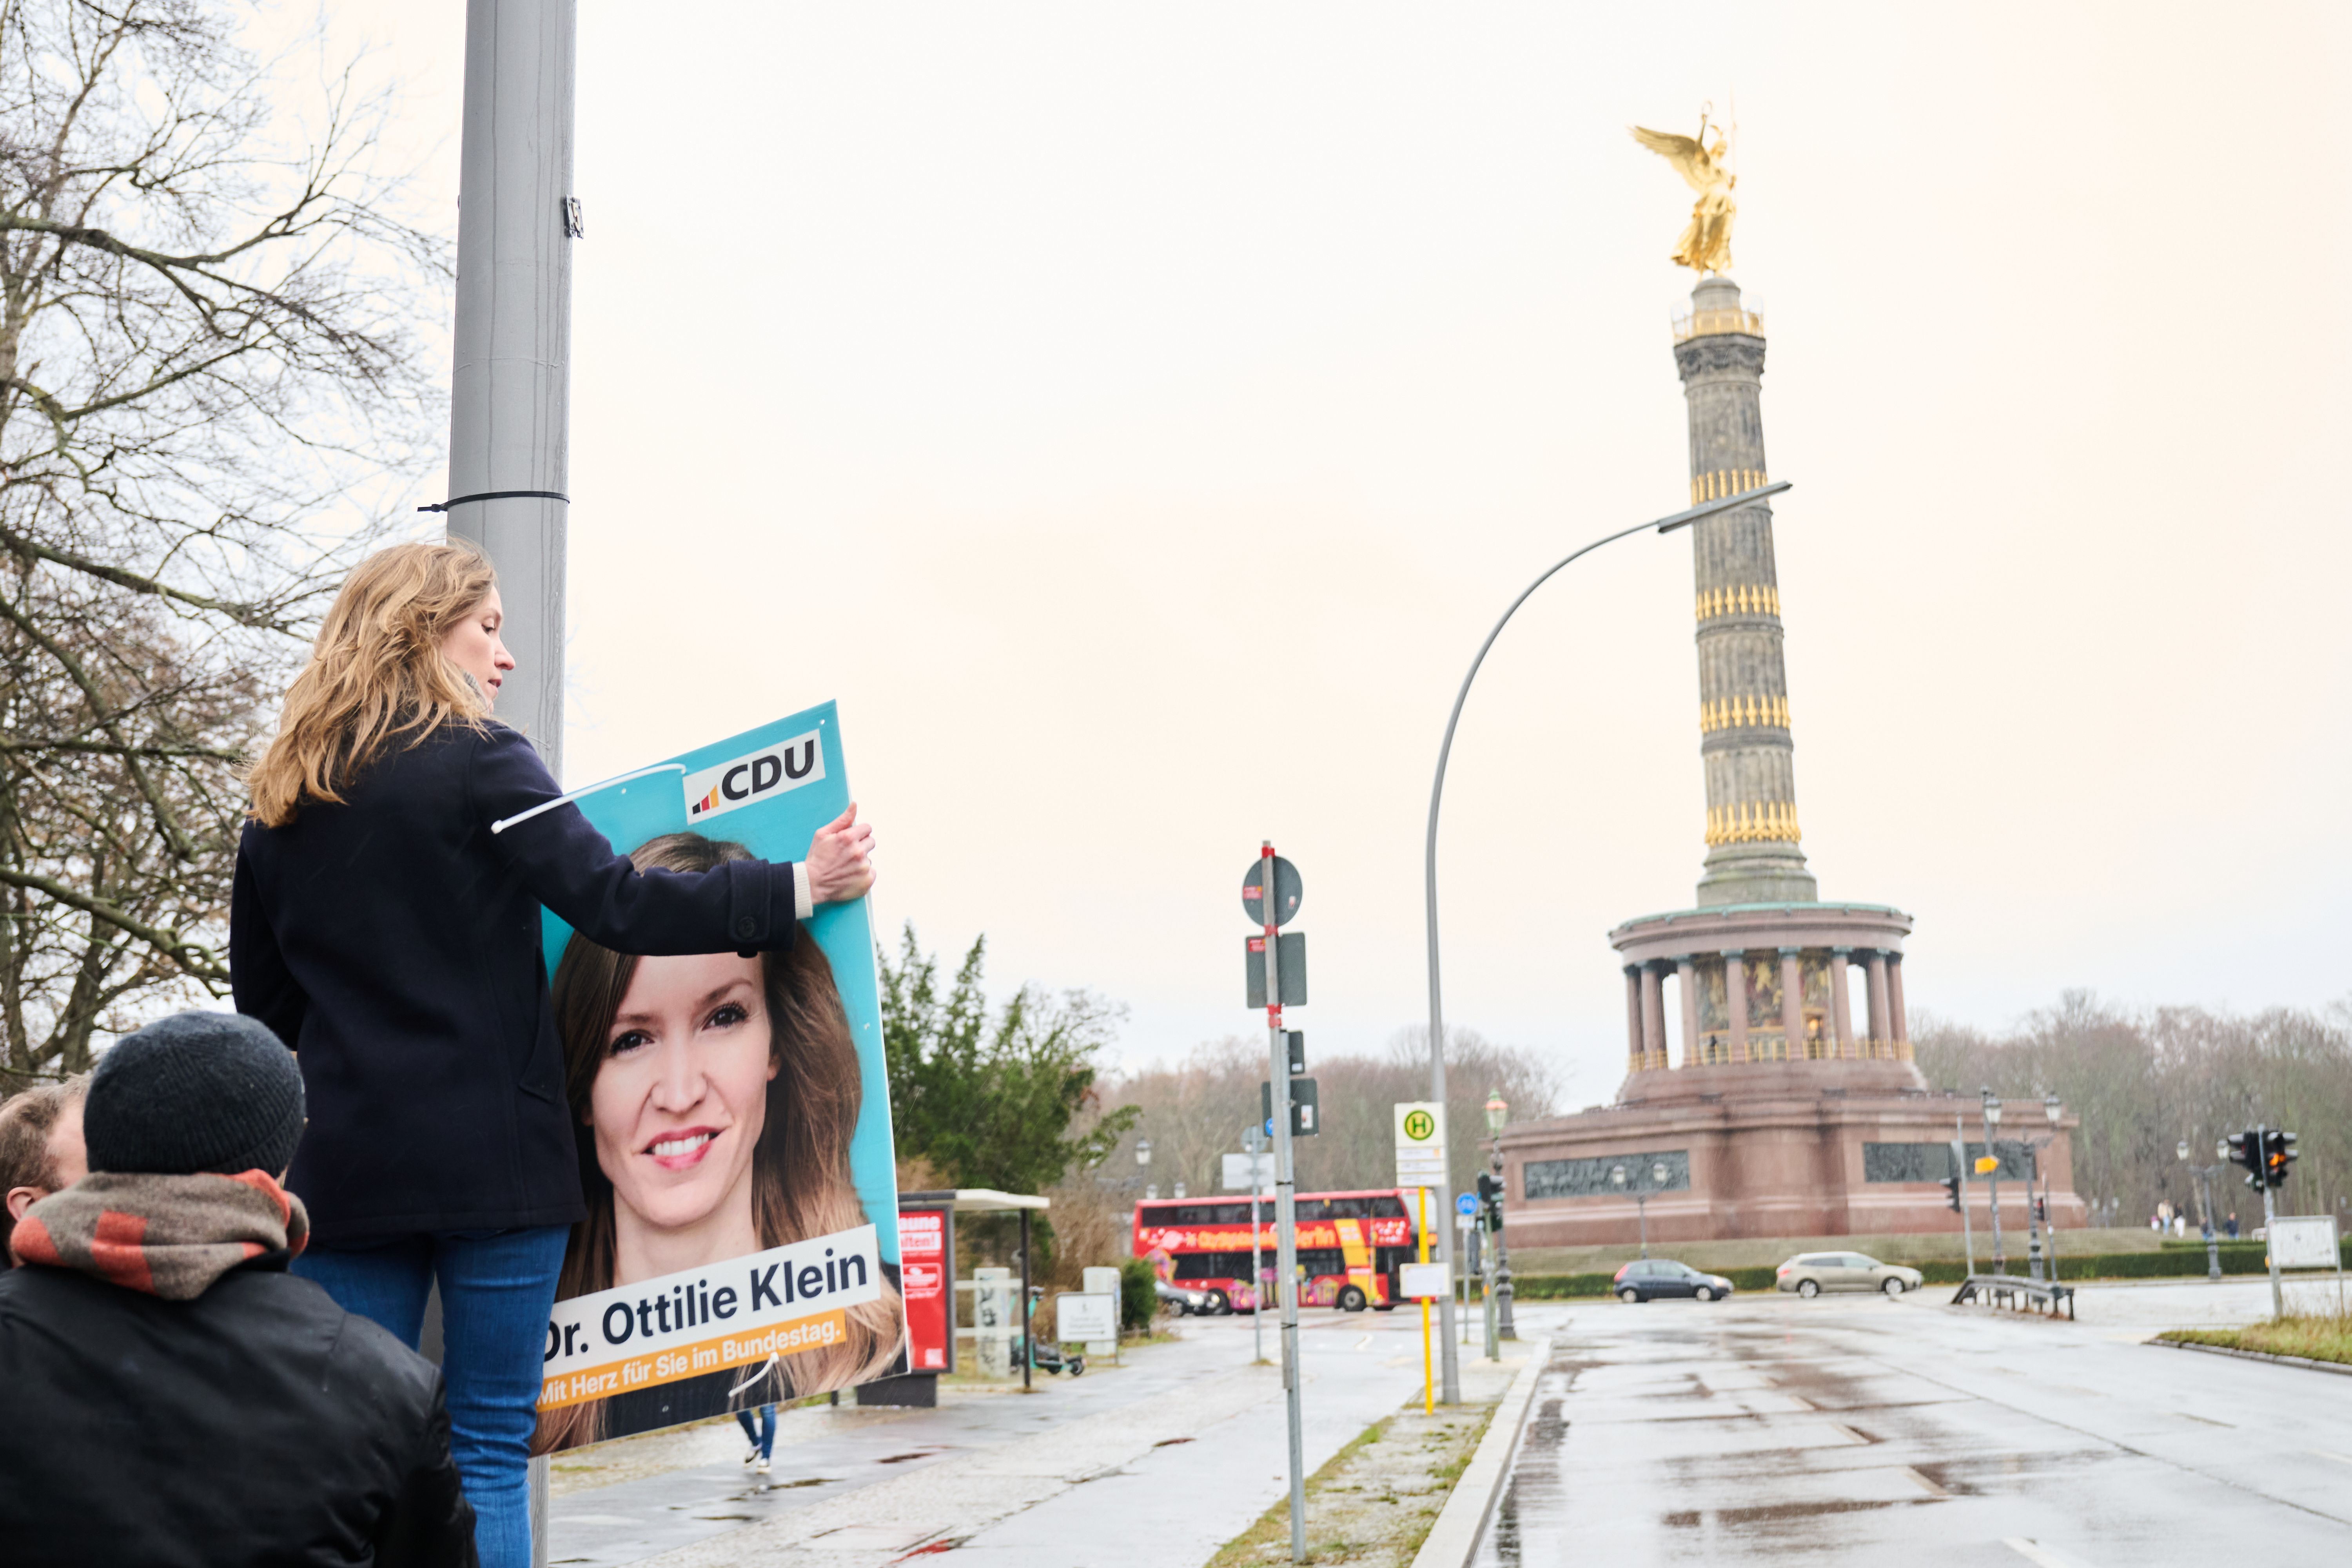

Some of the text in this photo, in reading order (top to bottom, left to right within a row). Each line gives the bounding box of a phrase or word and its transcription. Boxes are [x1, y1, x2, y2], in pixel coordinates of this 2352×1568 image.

[722, 739, 814, 800] CDU
[1412, 1118, 1426, 1133] H
[603, 1279, 738, 1345] Ottilie
[750, 1247, 867, 1312] Klein
[537, 1320, 841, 1406] Mit Herz für Sie im Bundestag.
